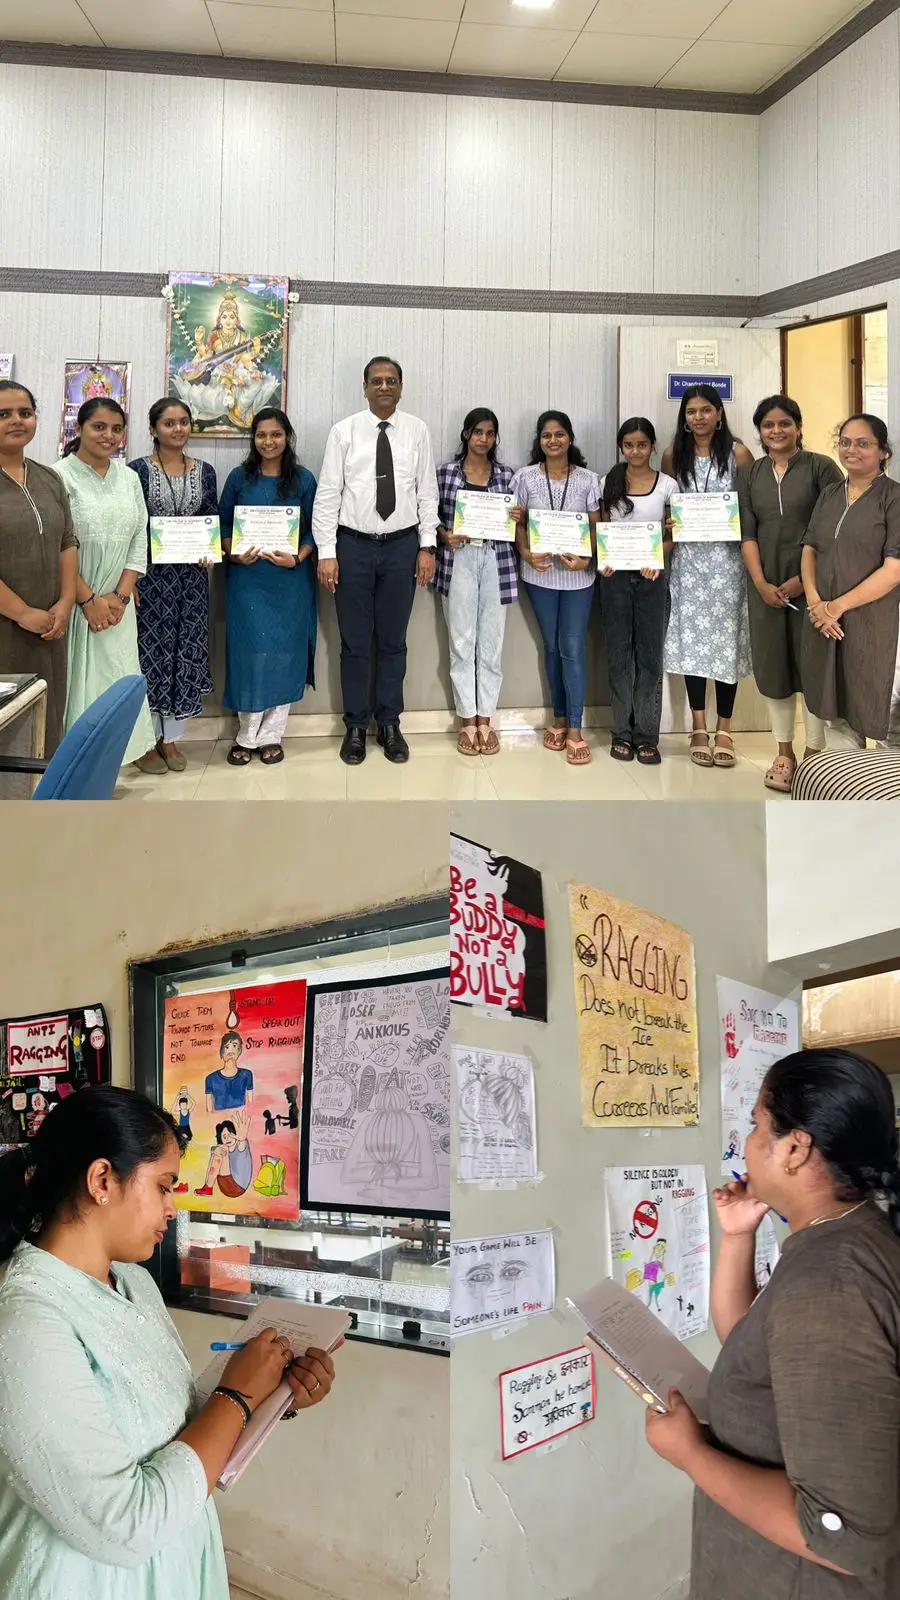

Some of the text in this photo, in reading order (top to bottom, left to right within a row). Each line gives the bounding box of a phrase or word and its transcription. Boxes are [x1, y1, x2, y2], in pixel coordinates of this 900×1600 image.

[450, 865, 477, 899] Be
[593, 913, 689, 1001] RAGGING
[580, 973, 615, 1016] Does
[617, 996, 641, 1023] not
[673, 1012, 691, 1033] the
[171, 1006, 213, 1019] GUIDE THEM
[341, 1004, 376, 1018] LOSER
[193, 1023, 214, 1032] FUTURE
[262, 1016, 301, 1029] SPEAK OUT
[27, 1024, 55, 1037] ANTI
[355, 1022, 410, 1041] ANXIOUS
[632, 1026, 654, 1046] Ice
[171, 1040, 183, 1048] NOT
[246, 1036, 301, 1050] STOP RAGGING
[10, 1035, 67, 1066] RAGGING
[170, 1053, 186, 1063] END
[600, 1043, 621, 1074] It
[627, 1046, 668, 1076] breaks
[649, 1084, 669, 1118] And
[623, 1168, 679, 1180] SILENCE IS GOLDEN
[651, 1178, 684, 1190] BUT NOT IN
[672, 1188, 696, 1199] RAGGING
[452, 1236, 537, 1256] YOUR GAME WILL BE
[454, 1301, 542, 1328] SOMEONE'S LIFE PAIN
